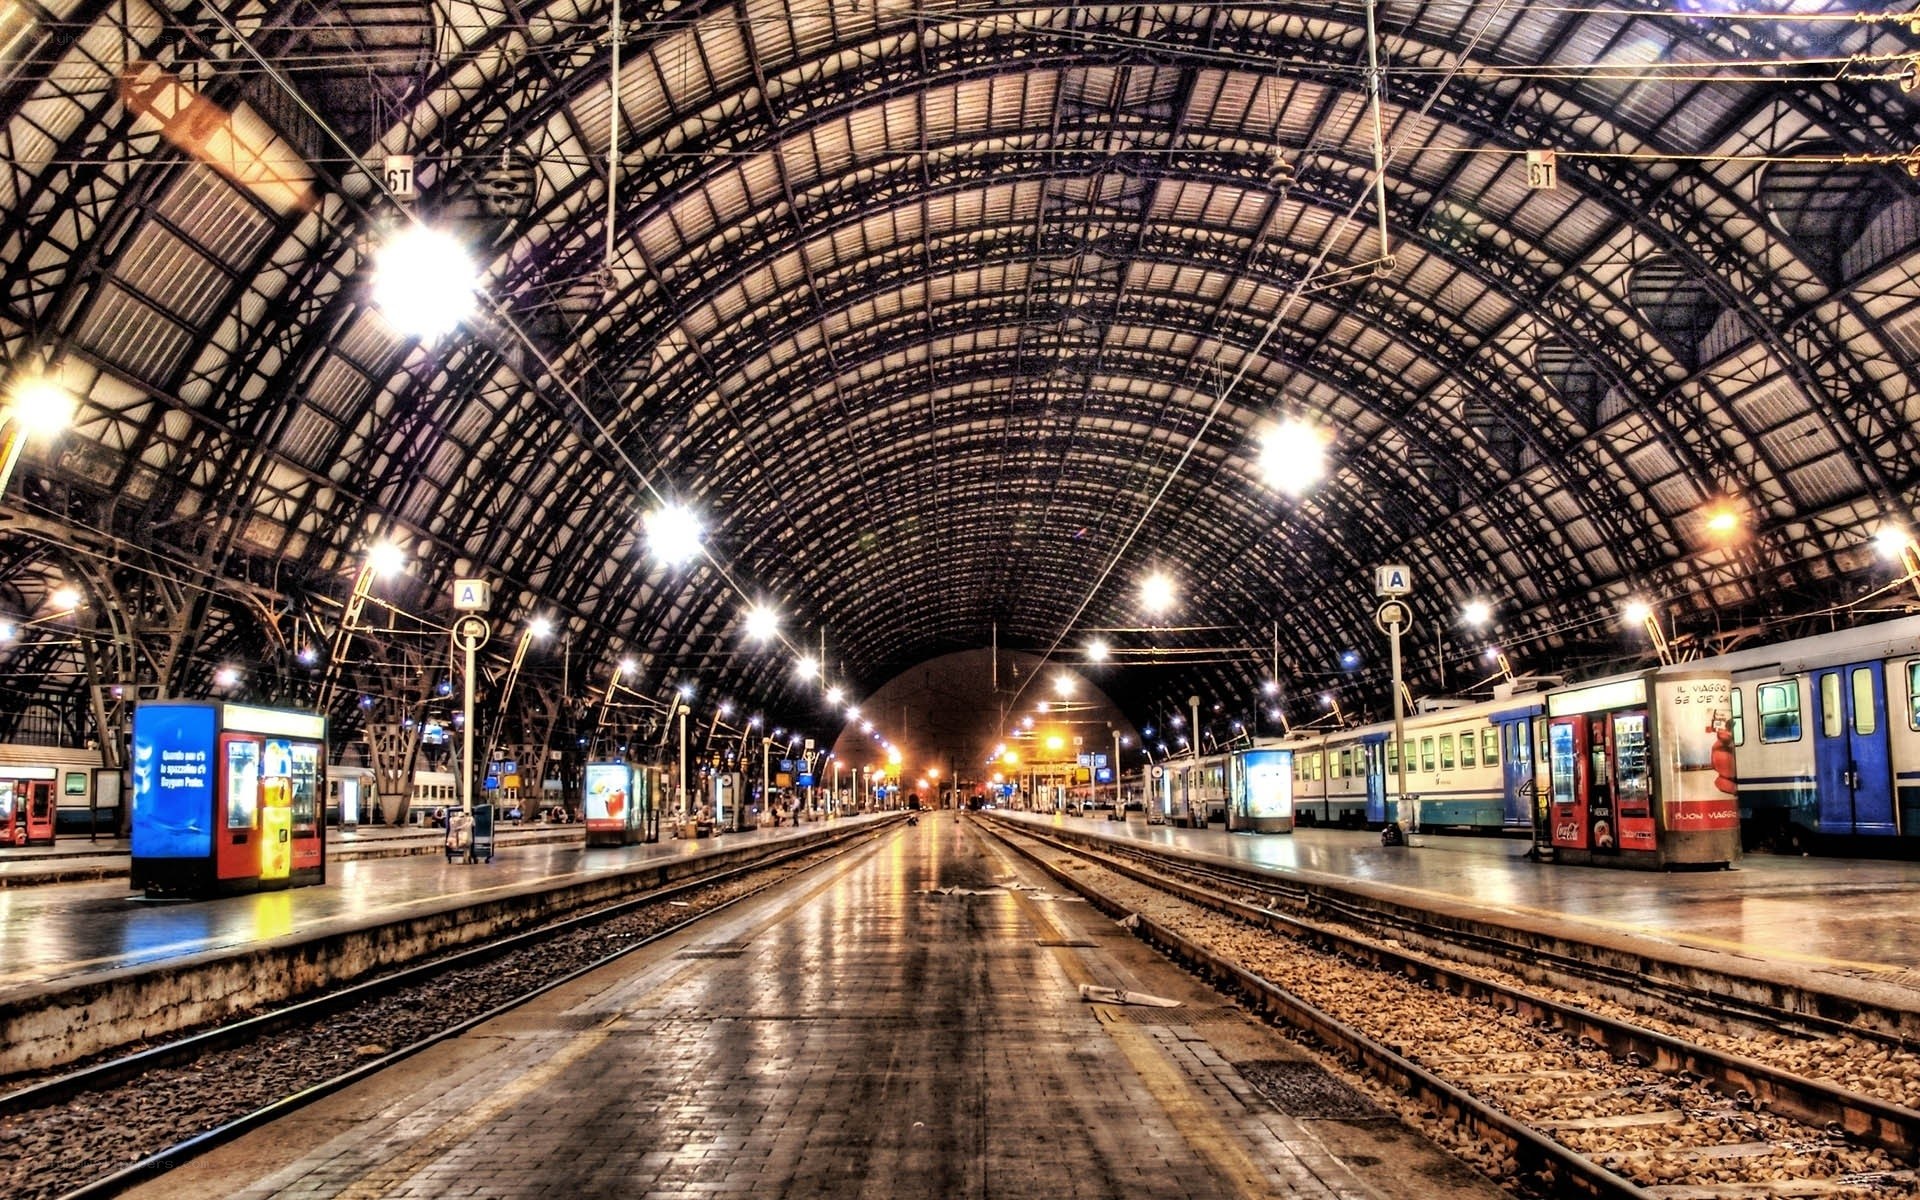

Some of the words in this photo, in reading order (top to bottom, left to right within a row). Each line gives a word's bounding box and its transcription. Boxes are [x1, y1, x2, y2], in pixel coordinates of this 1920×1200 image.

[1390, 571, 1404, 588] A
[461, 586, 475, 602] A
[1677, 685, 1686, 693] IL
[1674, 695, 1690, 705] SE
